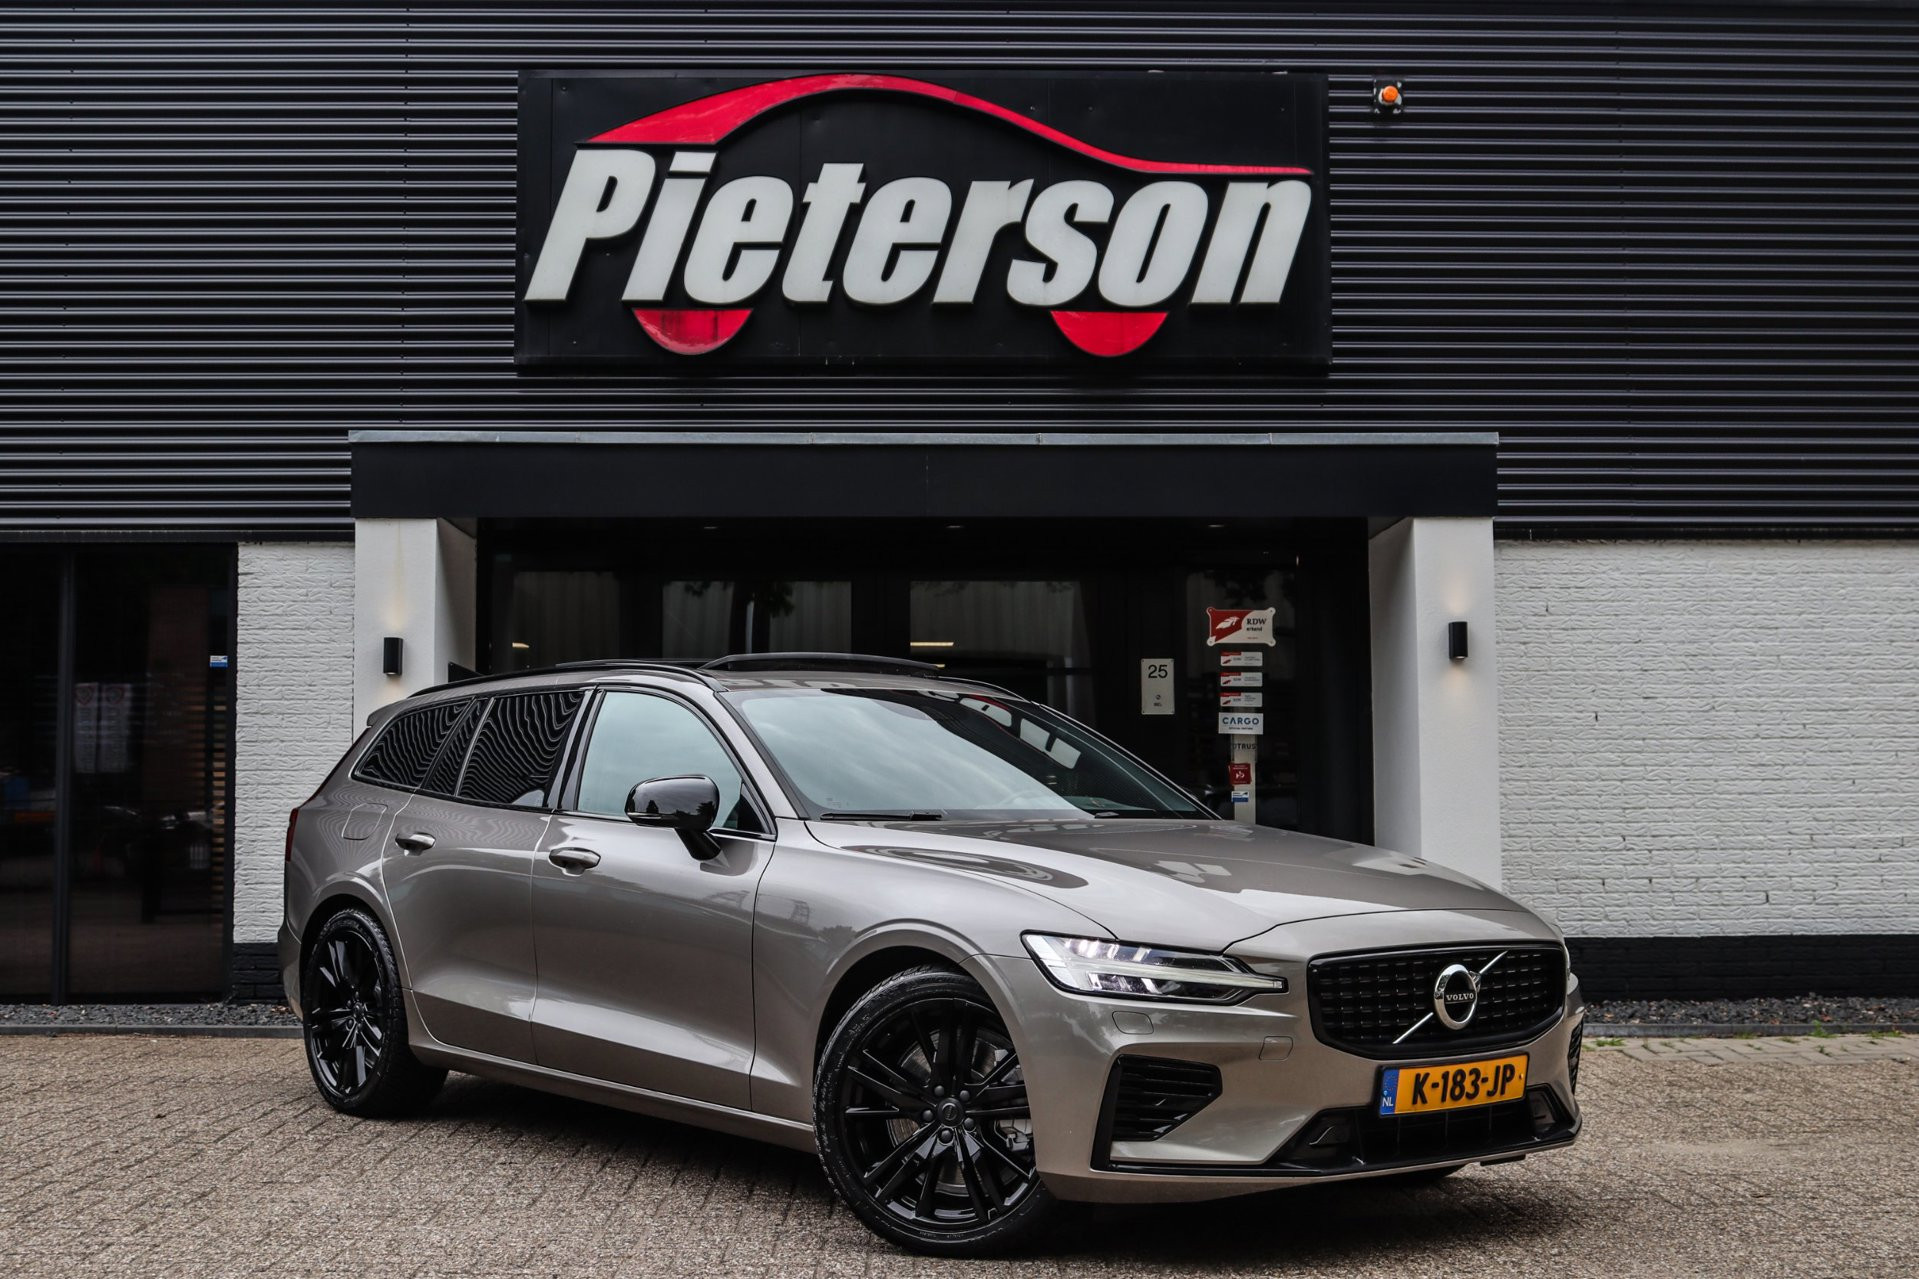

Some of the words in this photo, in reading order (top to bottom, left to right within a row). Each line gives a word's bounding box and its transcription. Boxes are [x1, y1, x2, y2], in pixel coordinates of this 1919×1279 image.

[524, 149, 1312, 308] Pieterson
[1148, 664, 1168, 679] 25
[1222, 717, 1260, 726] CARGO
[1446, 992, 1474, 1001] VOLVO
[1411, 1063, 1516, 1106] K-183-JP
[1382, 1096, 1394, 1107] NL
